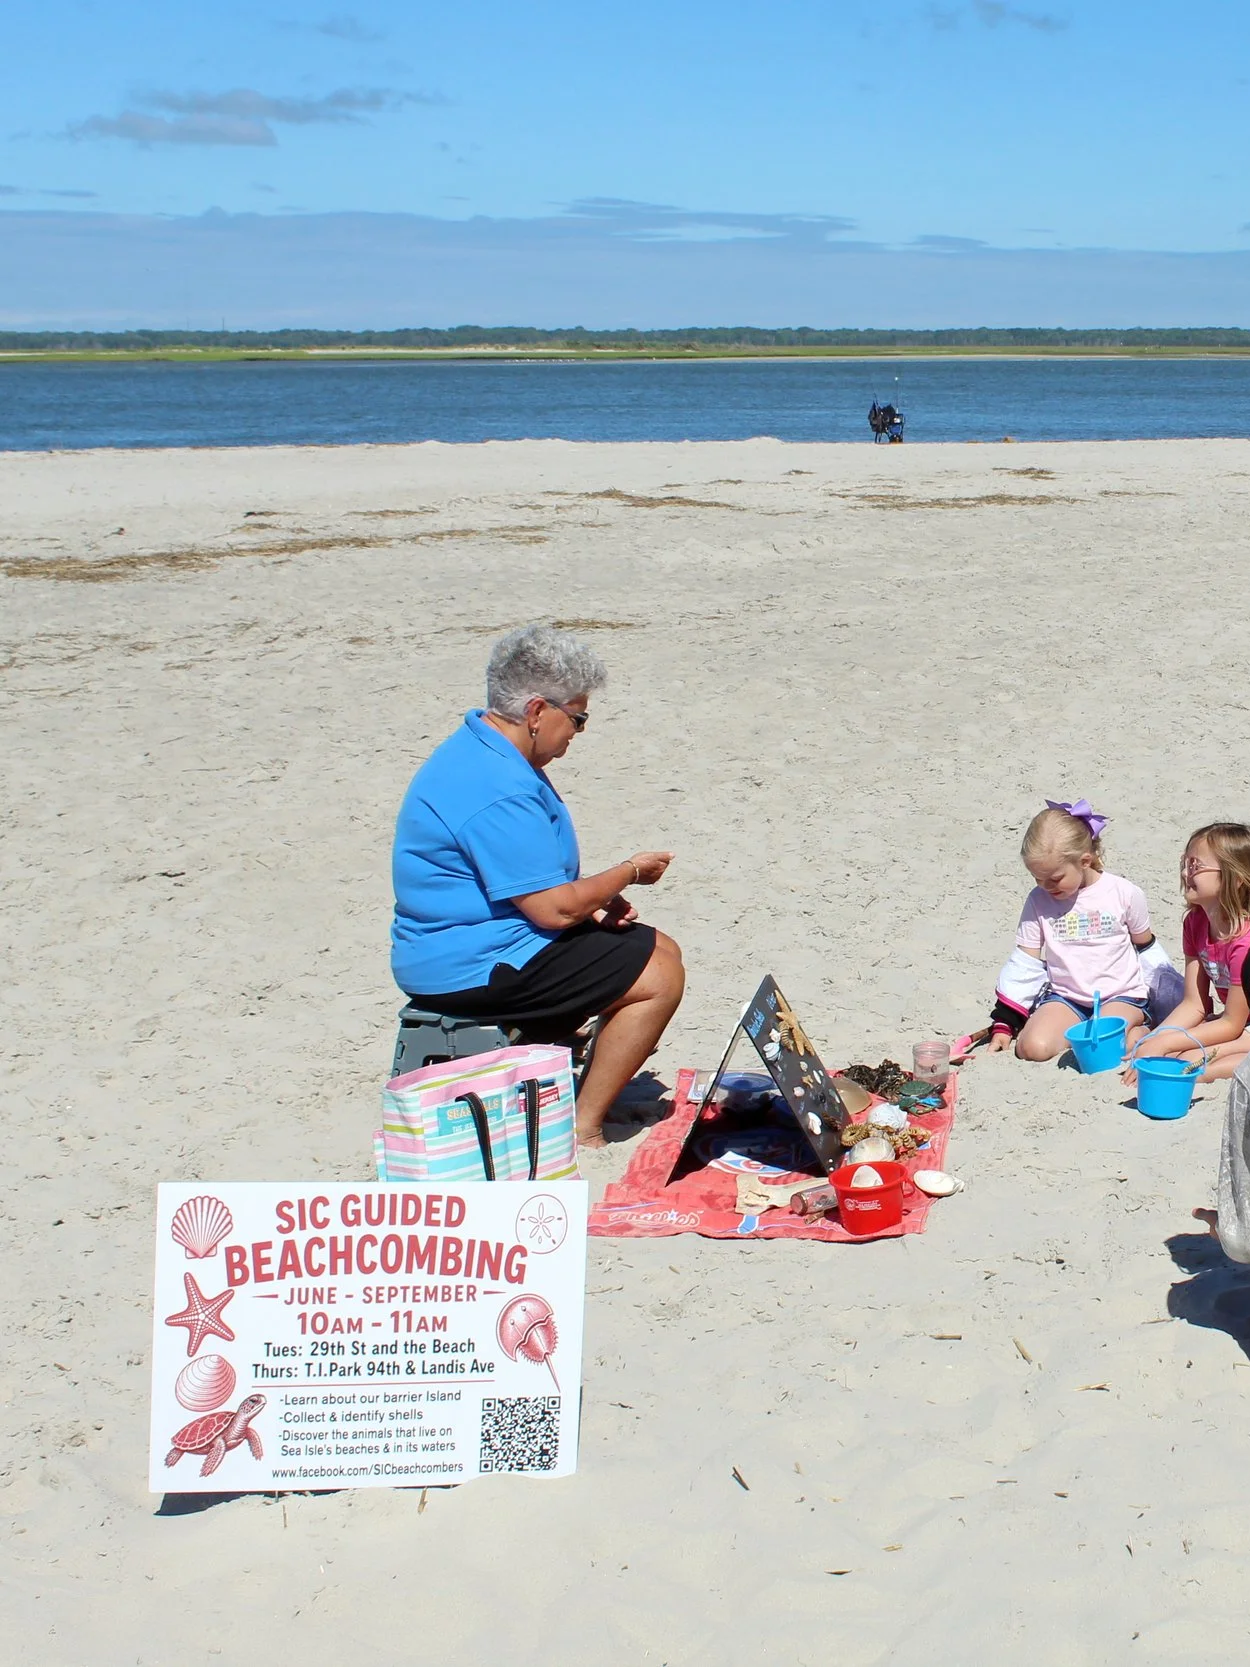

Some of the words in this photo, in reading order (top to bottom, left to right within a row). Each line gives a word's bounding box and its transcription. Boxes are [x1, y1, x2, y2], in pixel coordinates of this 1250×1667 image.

[275, 1195, 330, 1234] SIC
[340, 1193, 466, 1227] GUIDED
[224, 1233, 528, 1287] BEACHCOMBING
[284, 1287, 337, 1305] JUNE
[362, 1284, 477, 1304] SEPTEMBER
[297, 1311, 363, 1335] 10AM
[390, 1310, 448, 1334] 11AM
[264, 1341, 303, 1358] Tues:
[310, 1340, 345, 1357] 29th
[351, 1340, 367, 1356] St
[371, 1339, 398, 1356] and
[404, 1339, 427, 1355] the
[432, 1338, 476, 1354] Beach
[252, 1363, 299, 1379] Thurs:
[367, 1360, 400, 1376] 94th
[405, 1360, 416, 1375] &
[422, 1359, 466, 1375] Landis
[470, 1358, 496, 1374] Ave
[321, 1393, 356, 1405] about
[359, 1394, 380, 1404] our
[383, 1391, 423, 1403] barrier
[426, 1389, 462, 1402] Island
[329, 1411, 337, 1422] &
[341, 1409, 385, 1423] identify
[388, 1408, 424, 1421] shells
[331, 1427, 349, 1440] the
[351, 1426, 393, 1439] animals
[395, 1425, 416, 1438] that
[418, 1425, 437, 1437] live
[439, 1426, 453, 1436] on
[280, 1444, 301, 1456] Sea
[304, 1443, 332, 1456] Isle's
[335, 1441, 380, 1455] beaches
[382, 1442, 390, 1453] &
[393, 1441, 403, 1453] in
[405, 1440, 418, 1452] its
[421, 1440, 456, 1452] waters
[271, 1461, 464, 1478] www.facebook.com/SICbeachcombers
